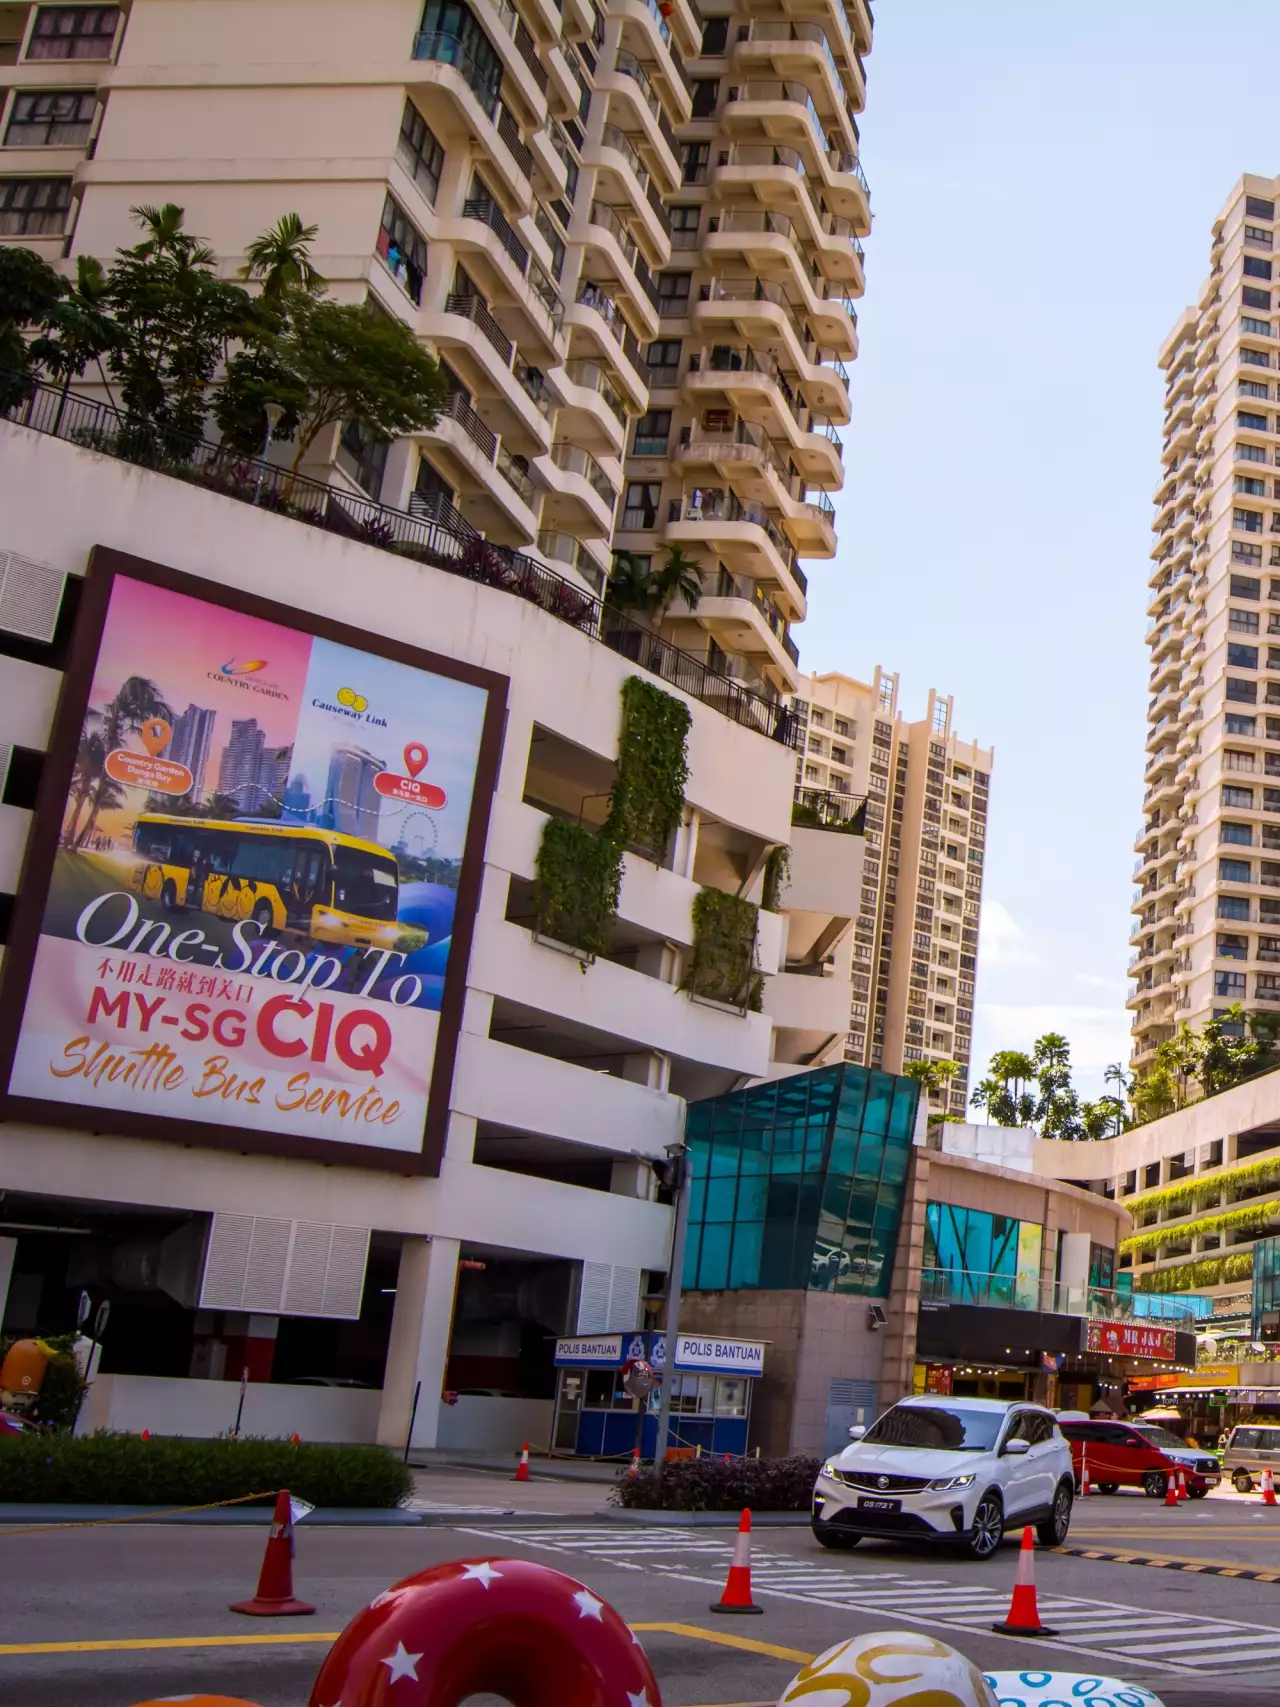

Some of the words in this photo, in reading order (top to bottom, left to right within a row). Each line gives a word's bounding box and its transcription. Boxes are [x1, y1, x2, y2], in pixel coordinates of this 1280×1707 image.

[207, 672, 252, 690] COUNTRY
[253, 685, 290, 701] GARDEN
[312, 698, 363, 721] Causeway
[366, 716, 388, 728] Link
[117, 753, 153, 770] Country
[400, 780, 421, 794] CIQ
[76, 891, 342, 1005] One-Stop
[363, 946, 422, 1007] To
[97, 956, 255, 1003] 不用走路就到关口
[86, 985, 248, 1048] MY-SG
[256, 993, 392, 1078] CIQ
[50, 1035, 188, 1093] Shuttle
[191, 1055, 266, 1105] Bus
[275, 1070, 404, 1125] Service
[558, 1343, 580, 1355] POLIS
[581, 1344, 617, 1355] BANTUAN
[1122, 1329, 1139, 1345] MR
[1141, 1332, 1161, 1348] J&J
[1133, 1346, 1153, 1354] CAFE
[683, 1341, 713, 1357] POLIS
[715, 1344, 761, 1361] BANTUAN
